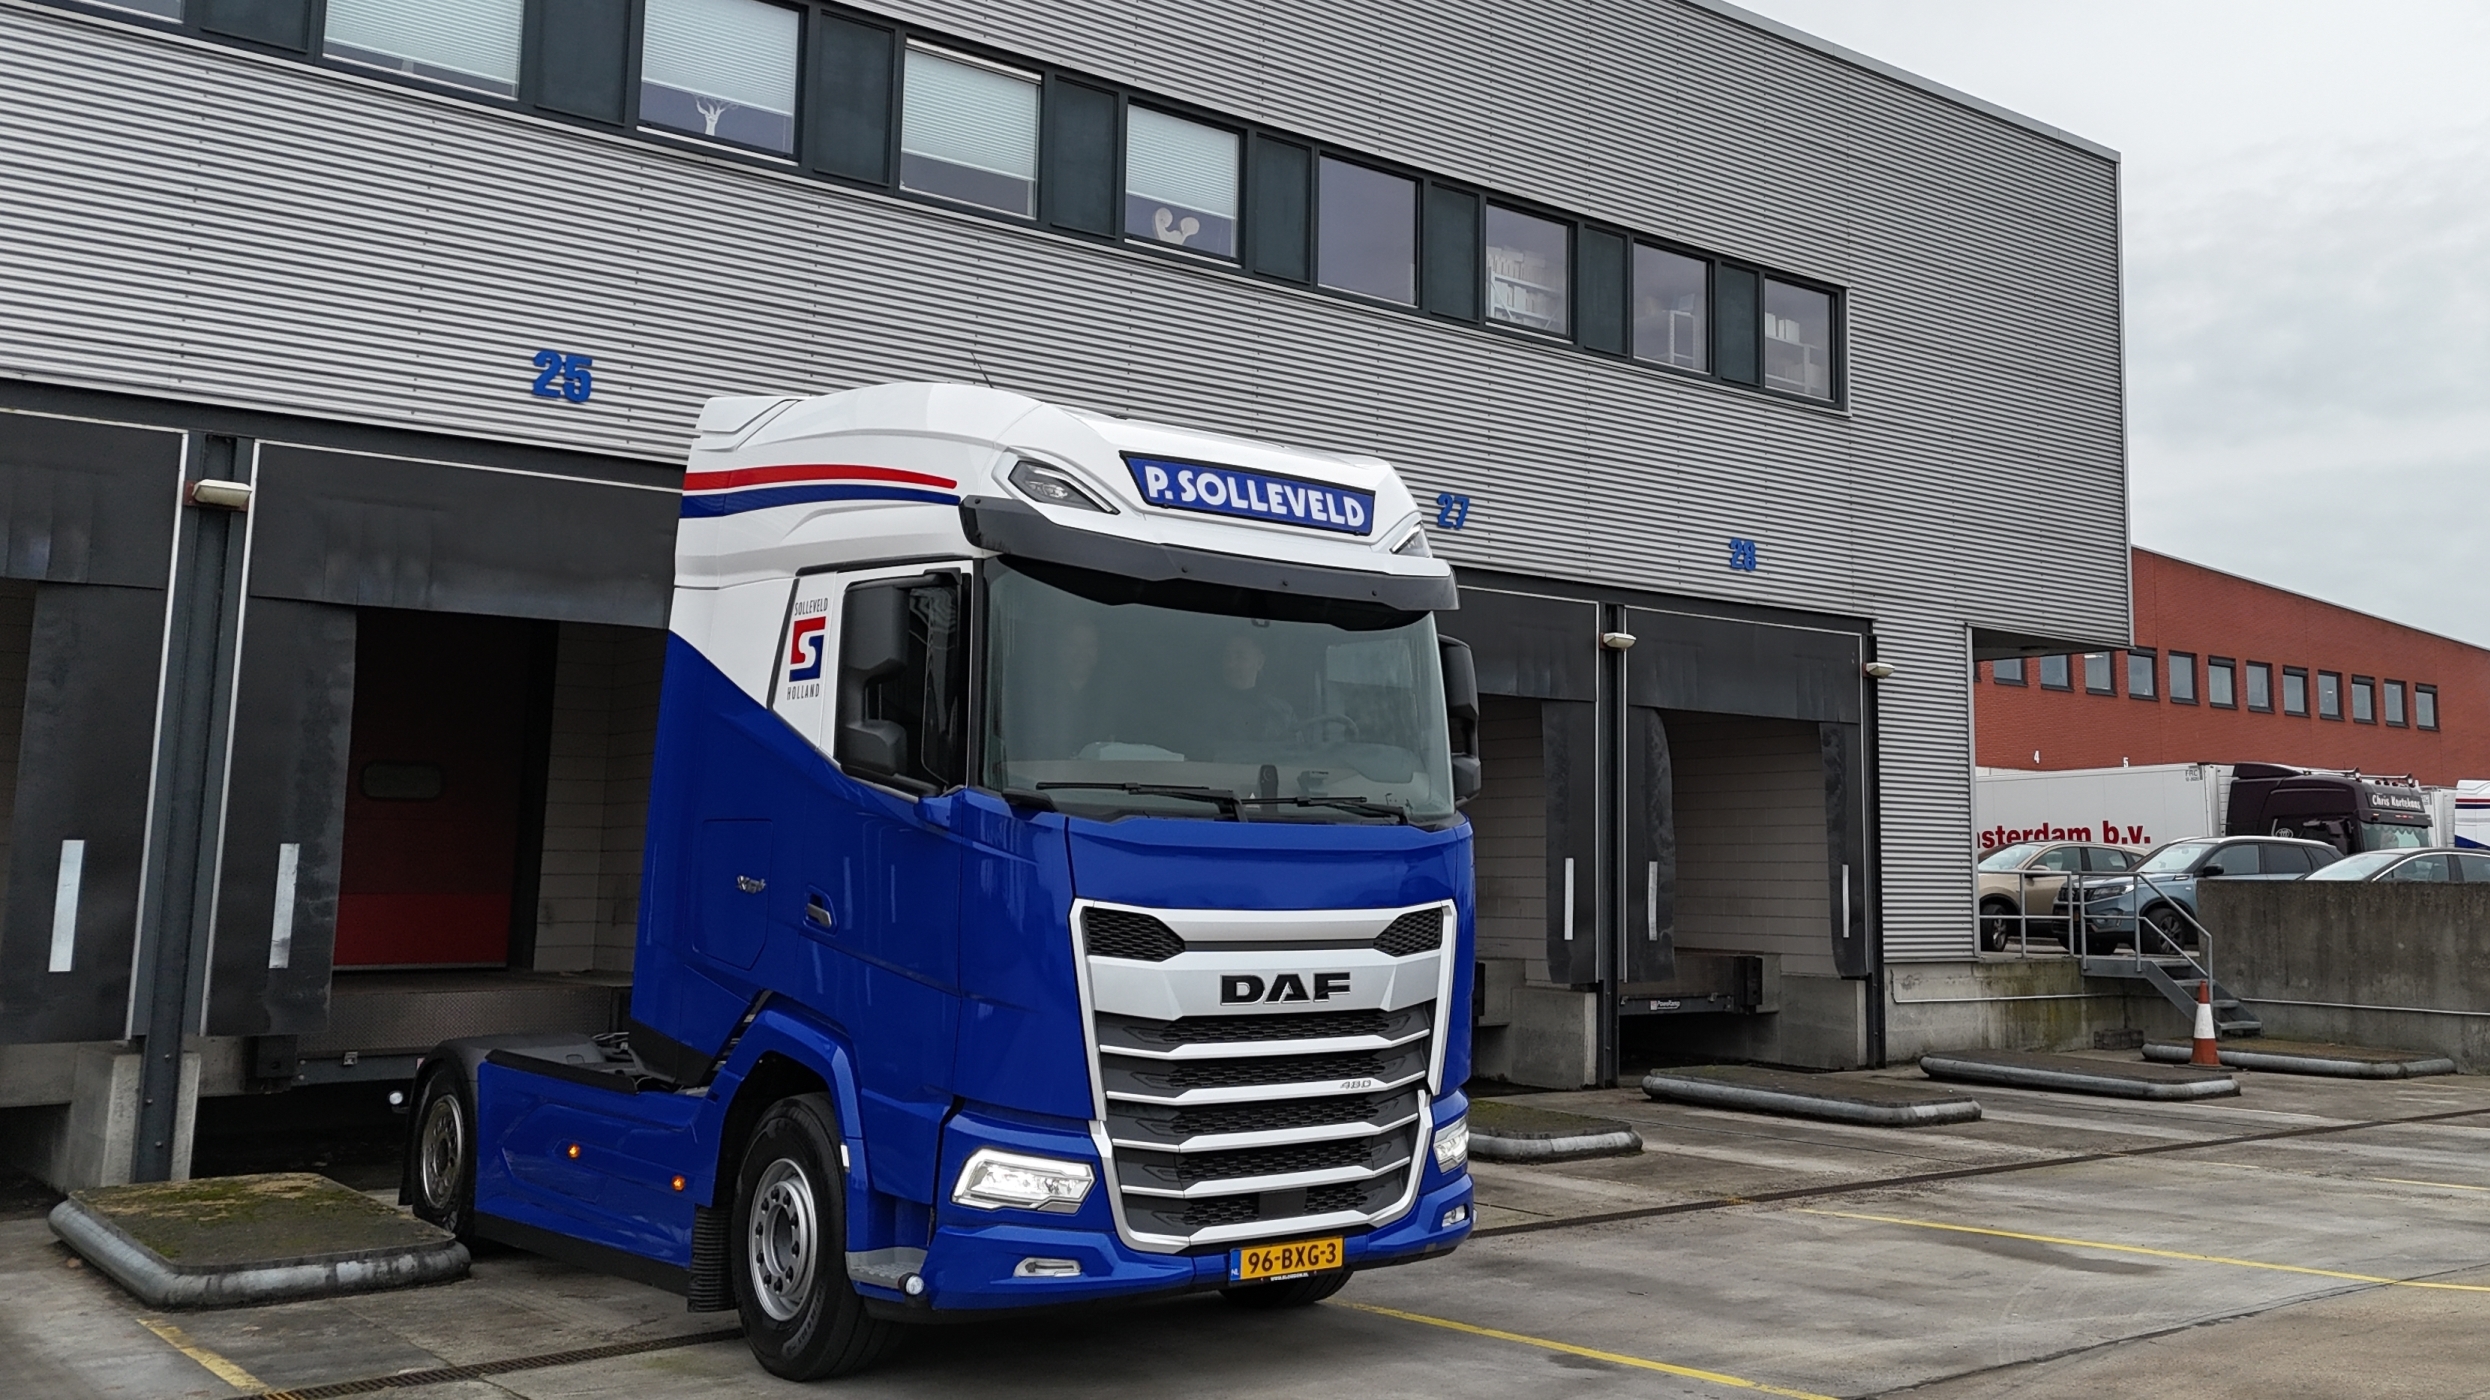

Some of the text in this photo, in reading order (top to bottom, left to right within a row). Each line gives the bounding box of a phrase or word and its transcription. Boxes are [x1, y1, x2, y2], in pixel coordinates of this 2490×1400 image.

[533, 349, 593, 402] 25
[1145, 465, 1365, 527] P. SOLLEVELD
[1437, 493, 1470, 529] 27
[1729, 537, 1756, 572] 28
[794, 597, 829, 616] SOLLEVELD
[787, 683, 820, 700] HOLLAND
[2034, 750, 2040, 764] 4
[2123, 757, 2129, 768] 5
[2372, 794, 2390, 807] Chris
[1976, 820, 2151, 848] sterdam b.v.
[1220, 972, 1351, 1005] DAF
[1340, 1080, 1371, 1089] 480
[1248, 1242, 1336, 1274] 96-BXG-3
[1231, 1268, 1239, 1276] NL
